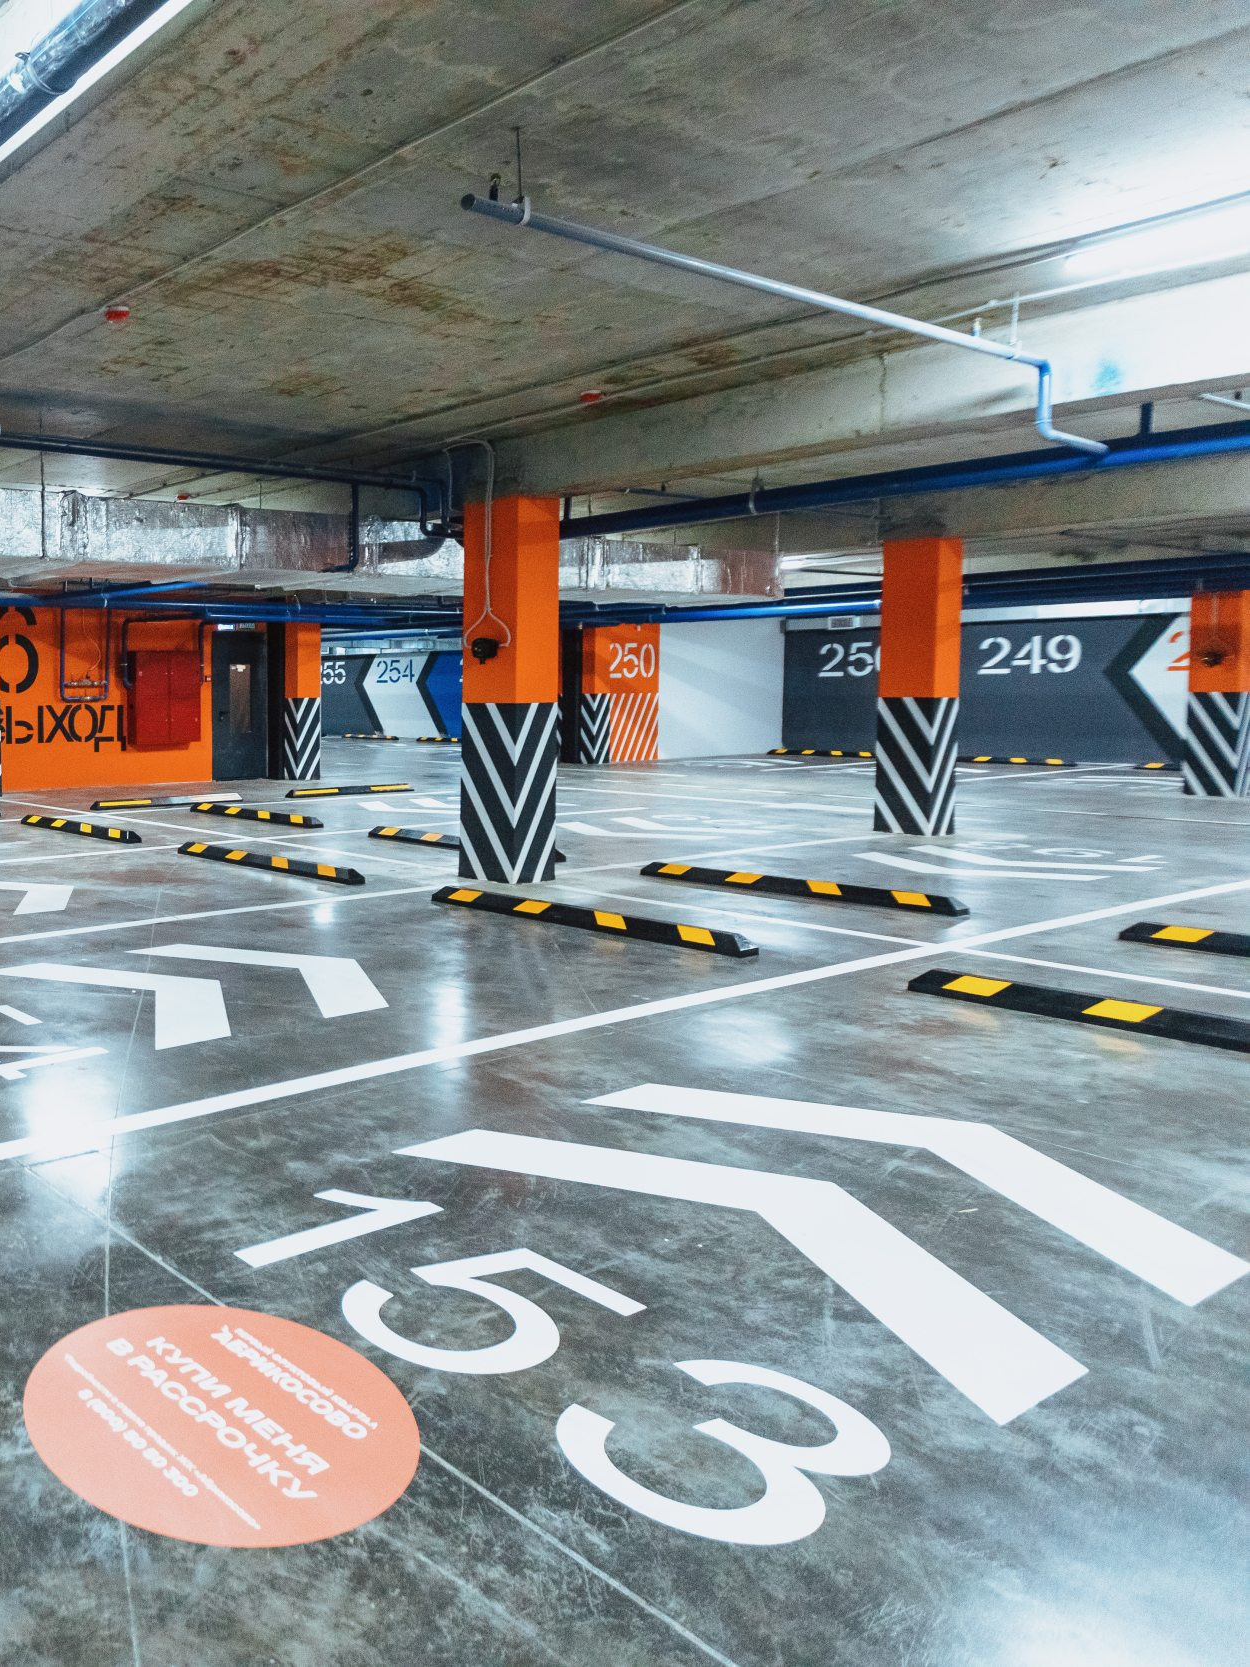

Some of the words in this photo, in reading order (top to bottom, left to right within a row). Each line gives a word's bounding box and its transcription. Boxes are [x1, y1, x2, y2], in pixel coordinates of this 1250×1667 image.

[320, 661, 346, 685] 55
[376, 659, 415, 683] 254
[609, 642, 655, 678] 250
[977, 634, 1082, 675] 249
[0, 704, 127, 752] ЫХОД
[210, 1324, 368, 1440] АБРИКОСОВО
[233, 1188, 892, 1545] 153
[105, 1337, 135, 1357] В
[127, 1353, 319, 1500] РАССРОЧКУ
[145, 1336, 232, 1398] КУПИ
[225, 1396, 330, 1477] МЕНЯ
